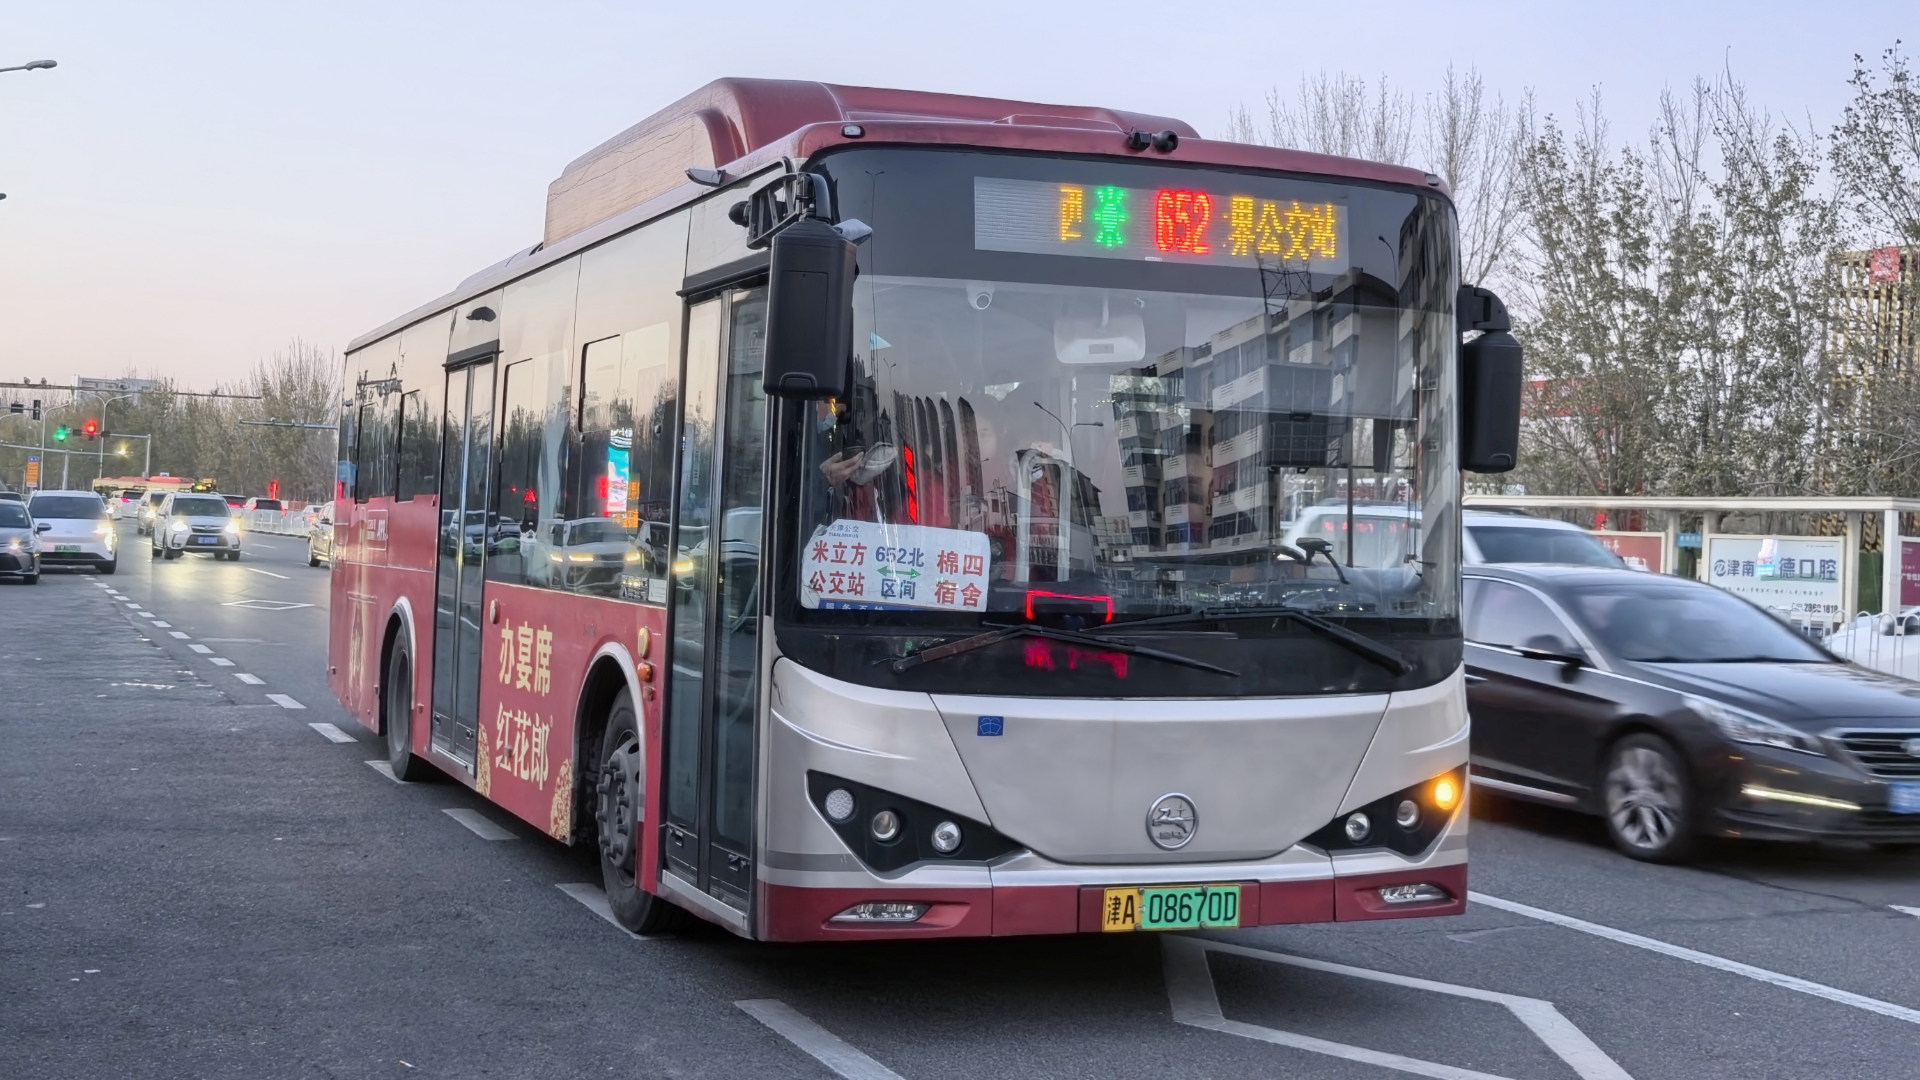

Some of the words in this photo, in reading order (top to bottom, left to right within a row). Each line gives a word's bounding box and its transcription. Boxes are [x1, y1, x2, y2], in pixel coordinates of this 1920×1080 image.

[1157, 191, 1209, 254] 652
[812, 540, 868, 566] 米立方
[937, 550, 984, 576] 棉四
[1726, 557, 1837, 580] 津南德口腔
[810, 570, 866, 596] 公交站
[880, 578, 916, 600] 区间
[934, 580, 982, 607] 宿舍
[499, 618, 553, 697] 办宴席
[495, 701, 551, 790] 红花郎
